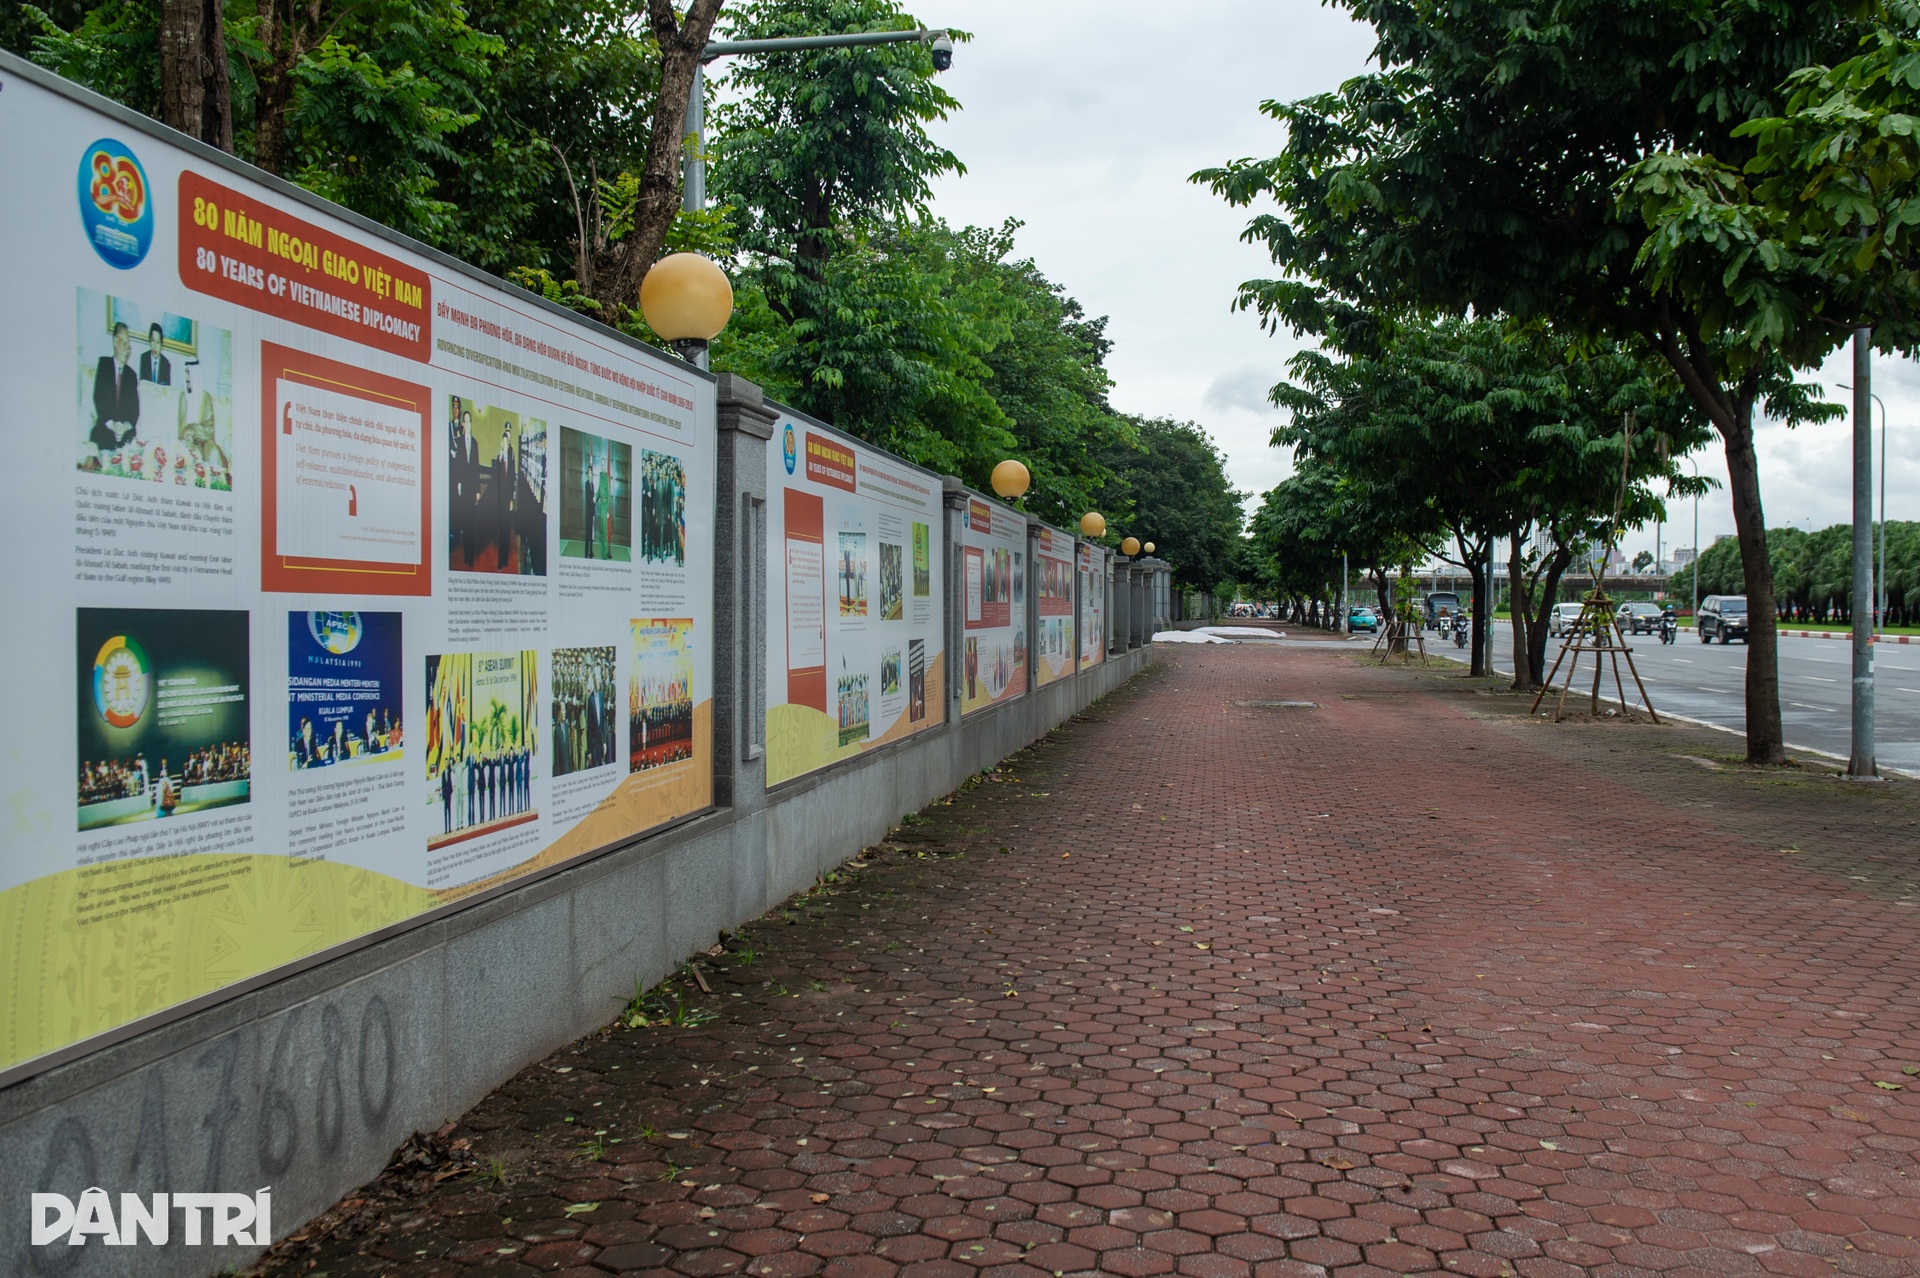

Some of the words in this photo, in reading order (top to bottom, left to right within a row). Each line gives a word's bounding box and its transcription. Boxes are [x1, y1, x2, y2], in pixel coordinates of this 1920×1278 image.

[194, 195, 218, 232] 80
[224, 208, 262, 248] NĂM
[268, 225, 318, 274] NGOẠI
[323, 248, 358, 285] GIAO
[363, 264, 390, 300] VIỆT
[395, 277, 421, 309] NAM
[196, 245, 216, 274] 80
[221, 254, 263, 290] YEARS
[267, 271, 285, 297] OF
[290, 279, 359, 323] VIETNAMESE
[363, 305, 419, 343] DIPLOMACY
[437, 299, 449, 320] ĐẨY
[450, 307, 469, 327] MẠNH
[470, 315, 478, 330] ĐA
[478, 318, 500, 339] PHƯƠNG
[514, 332, 522, 347] ĐA
[522, 335, 536, 352] DẠNG
[537, 338, 546, 356] HÓA
[547, 345, 560, 361] QUAN
[560, 347, 566, 366] HỆ
[436, 337, 465, 358] ADVANCING
[465, 347, 502, 370] DIVERSIFICATION
[502, 360, 511, 374] AND
[512, 363, 553, 388] MULTILATERALIZATION
[553, 378, 558, 389] OF
[558, 379, 575, 395] EXTERNAL
[612, 398, 628, 412] DEEPENING
[629, 404, 649, 420] INTERNATIONAL
[296, 403, 305, 415] Việt
[308, 406, 320, 417] Nam
[336, 412, 346, 424] hiện
[349, 416, 362, 426] chính
[364, 419, 374, 428] sách
[385, 425, 396, 435] ngoại
[315, 422, 321, 433] đa
[353, 430, 359, 440] đa
[381, 439, 392, 447] quan
[393, 439, 398, 450] hệ
[296, 442, 305, 453] Viet
[308, 445, 320, 456] Nam
[322, 450, 340, 459] pursues
[347, 452, 364, 465] foreign
[365, 456, 378, 468] policy
[380, 458, 385, 467] of
[295, 474, 300, 484] of
[302, 476, 322, 487] external
[375, 473, 384, 481] and
[386, 474, 415, 486] diversification
[75, 546, 101, 555] President
[113, 548, 123, 556] Duc
[127, 549, 137, 557] Anh
[140, 550, 158, 561] visiting
[160, 551, 175, 559] Kuwait
[189, 554, 207, 564] meeting
[129, 563, 150, 573] marking
[182, 565, 188, 574] by
[127, 575, 143, 584] region
[326, 620, 349, 630] APEC
[308, 656, 346, 668] MALAYSIA
[322, 678, 339, 687] MEDIA
[297, 692, 334, 702] MINISTERIAL
[335, 692, 352, 701] MEDIA
[352, 692, 380, 700] CONFERENCE
[318, 707, 335, 715] KUALA
